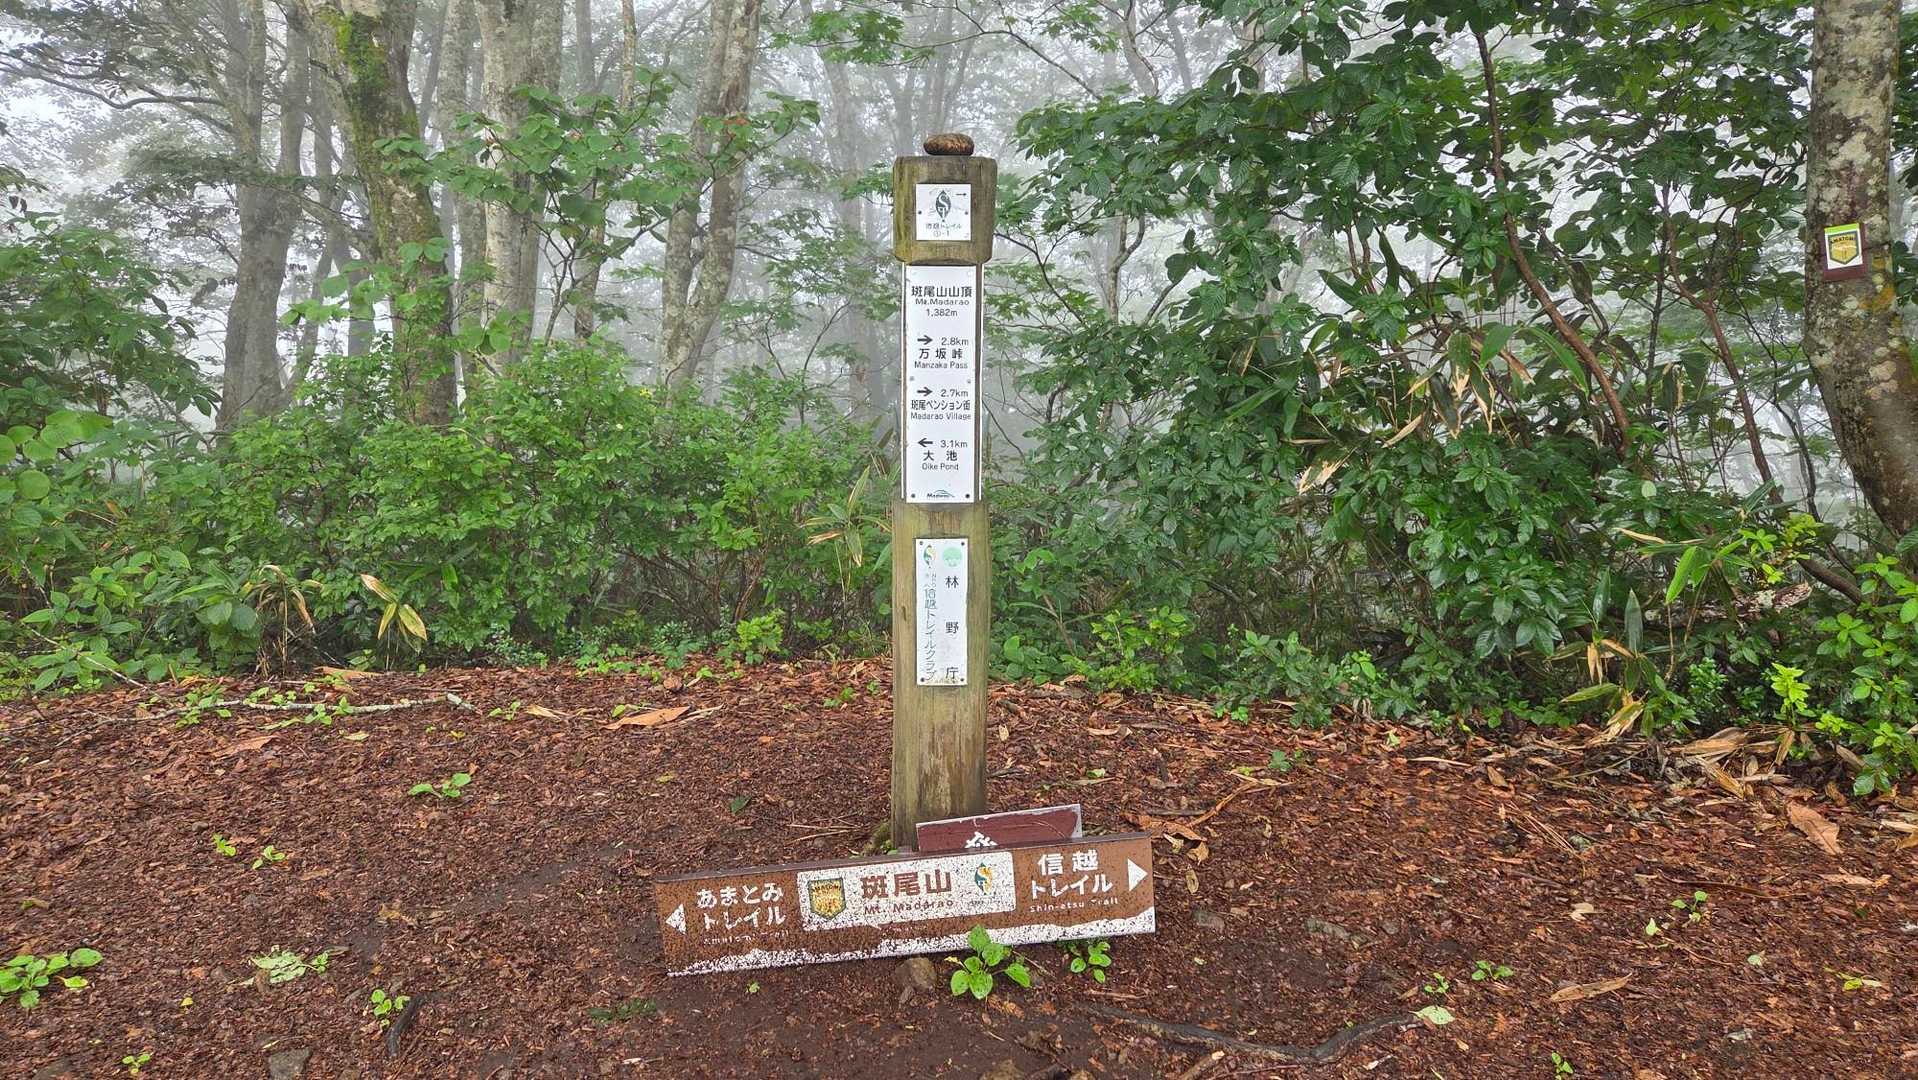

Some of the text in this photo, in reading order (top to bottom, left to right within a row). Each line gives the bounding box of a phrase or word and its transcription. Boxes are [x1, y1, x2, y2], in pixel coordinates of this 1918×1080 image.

[911, 286, 972, 297] 斑尾山山頂
[926, 308, 957, 317] 1,382m
[941, 337, 969, 346] 2.8km
[919, 348, 962, 359] 万坂峠
[914, 361, 968, 369] Manzaka Pass
[940, 388, 968, 397] 2.7km
[911, 399, 970, 410] 斑尾ペンション街
[911, 412, 971, 420] Madarao Village
[940, 440, 968, 448] 3.1km
[923, 450, 957, 461] 大池
[1037, 849, 1099, 876] 信越
[859, 869, 952, 899] 斑尾山
[1031, 874, 1114, 900] トレイル
[697, 883, 784, 908] あまとみ
[892, 900, 954, 914] Madarao
[703, 906, 787, 930] トレイル
